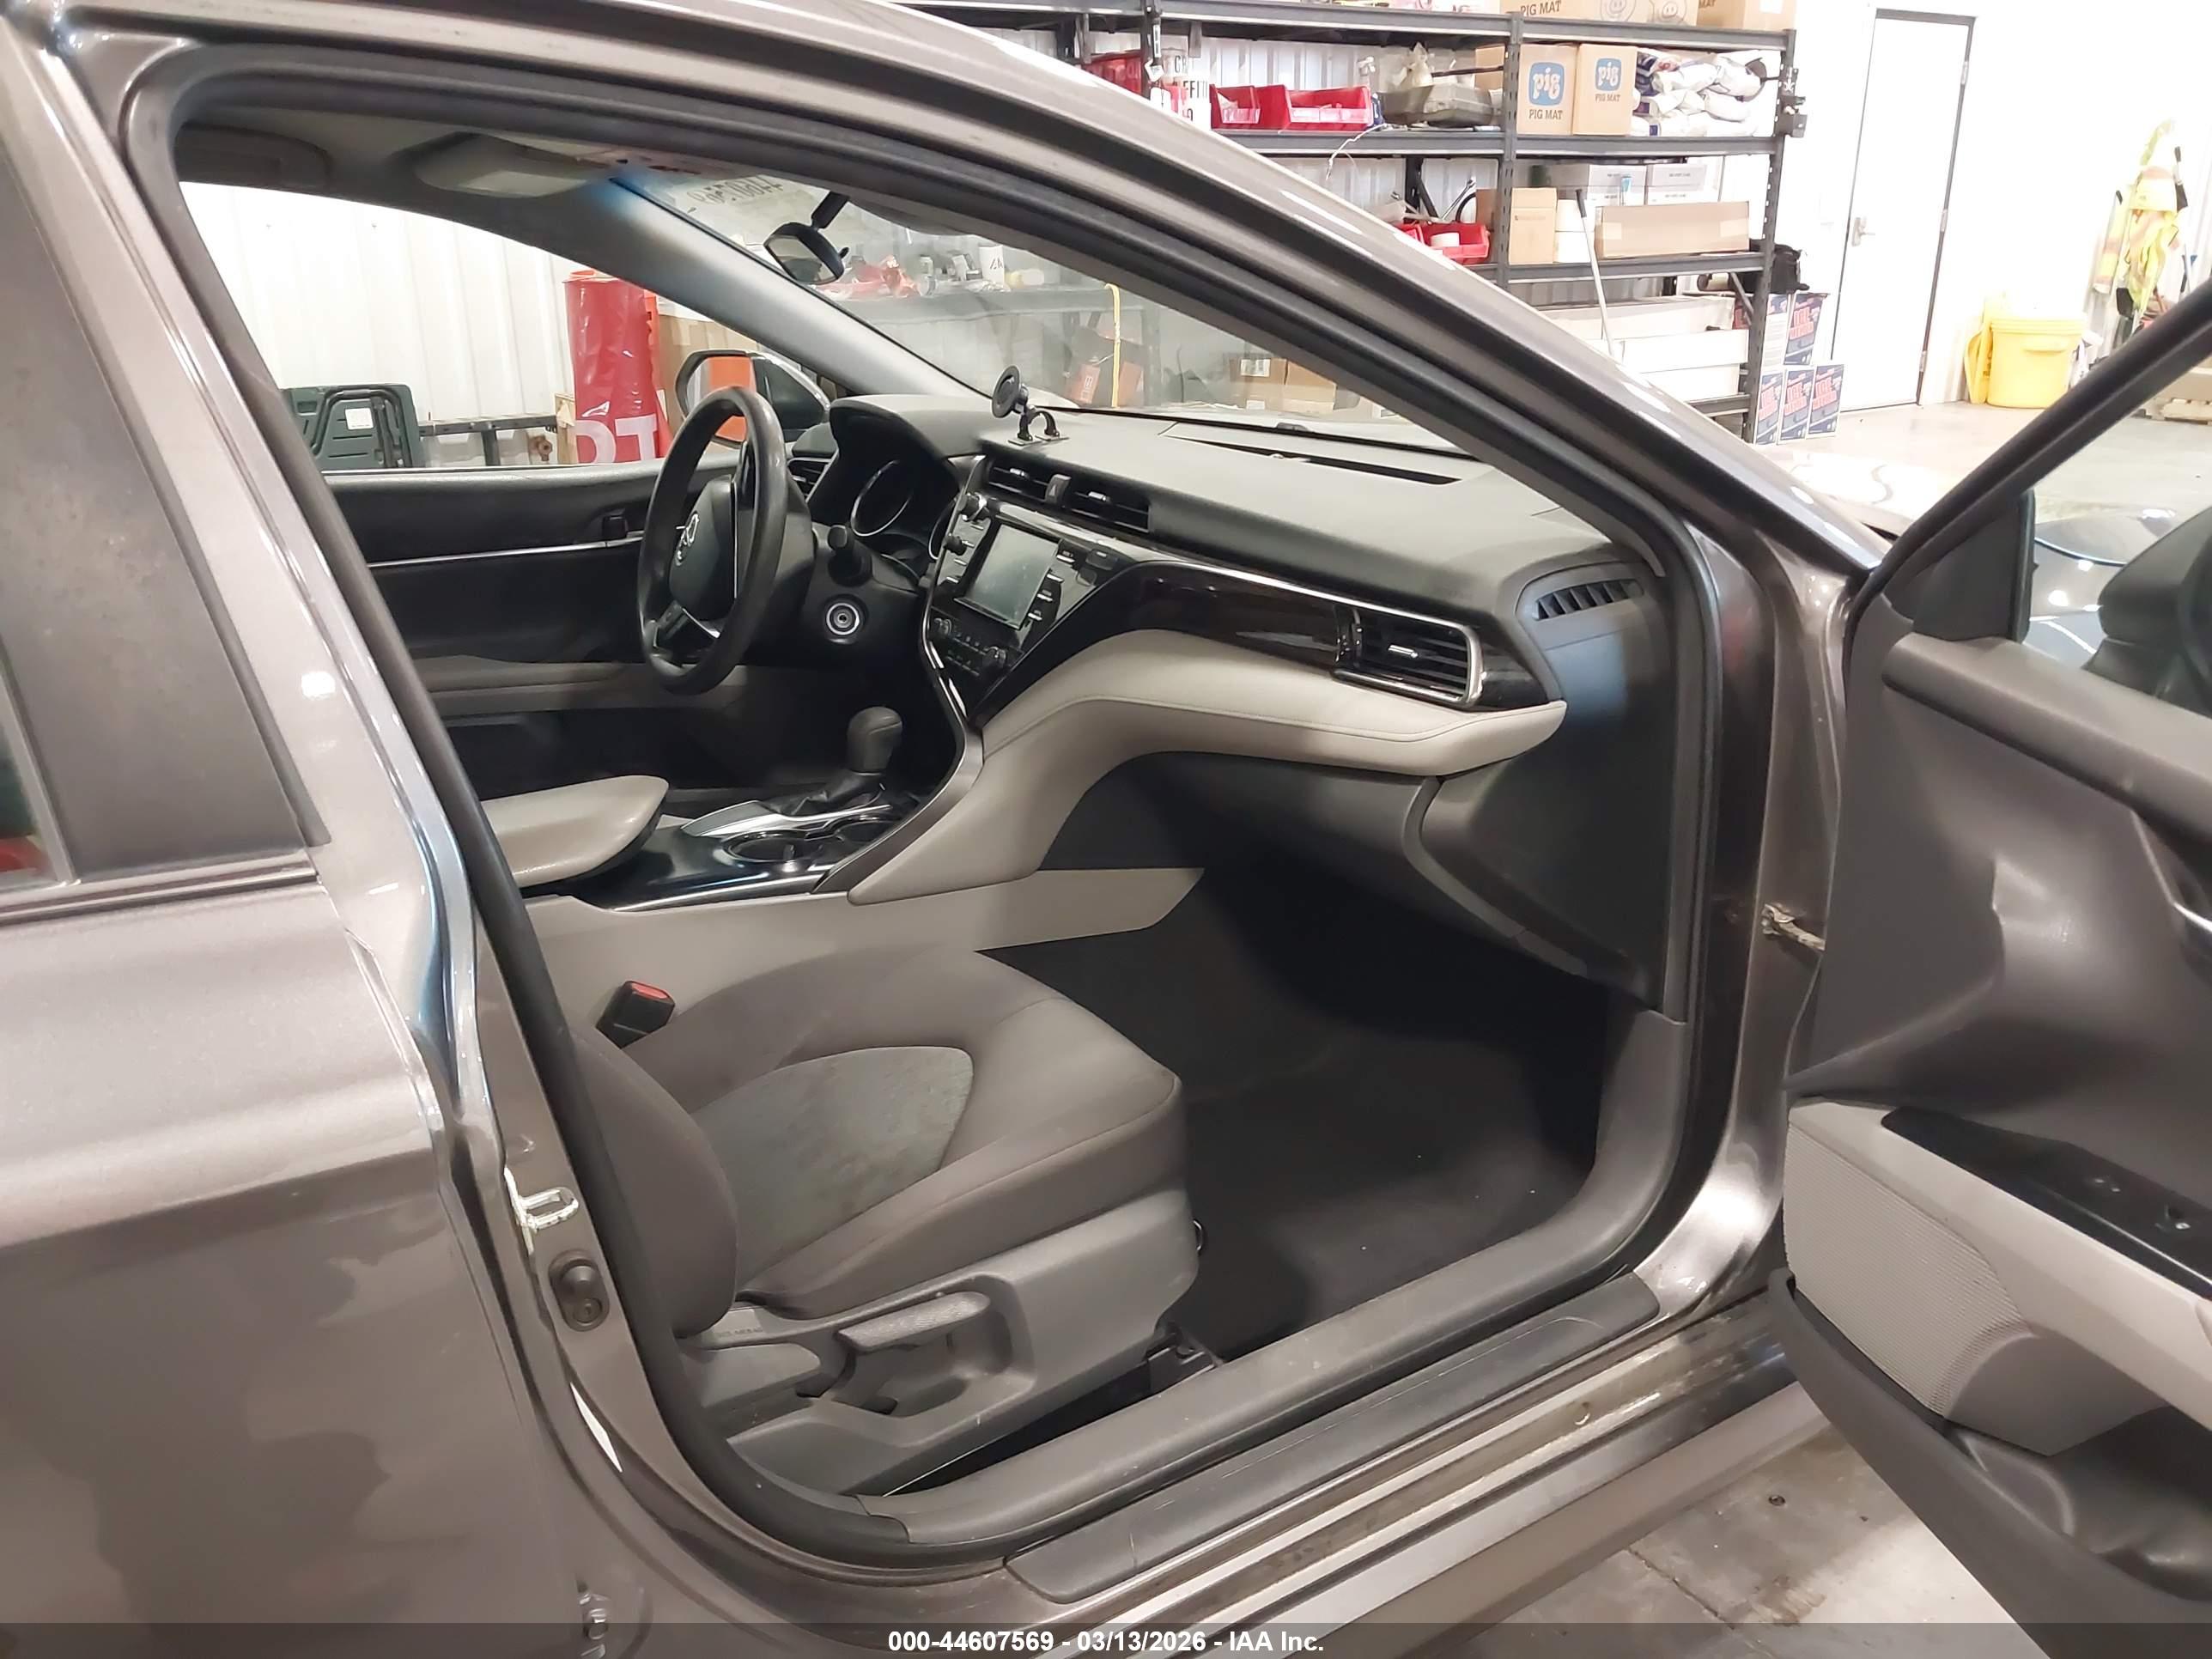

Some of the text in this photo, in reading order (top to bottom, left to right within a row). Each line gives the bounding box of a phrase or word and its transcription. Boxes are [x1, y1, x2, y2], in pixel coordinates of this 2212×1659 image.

[1521, 0, 1561, 15] PIG MAT
[1598, 61, 1620, 87] pig
[1533, 67, 1561, 100] pig
[1595, 94, 1620, 102] PIG MAT
[1528, 109, 1563, 119] PIG MAT
